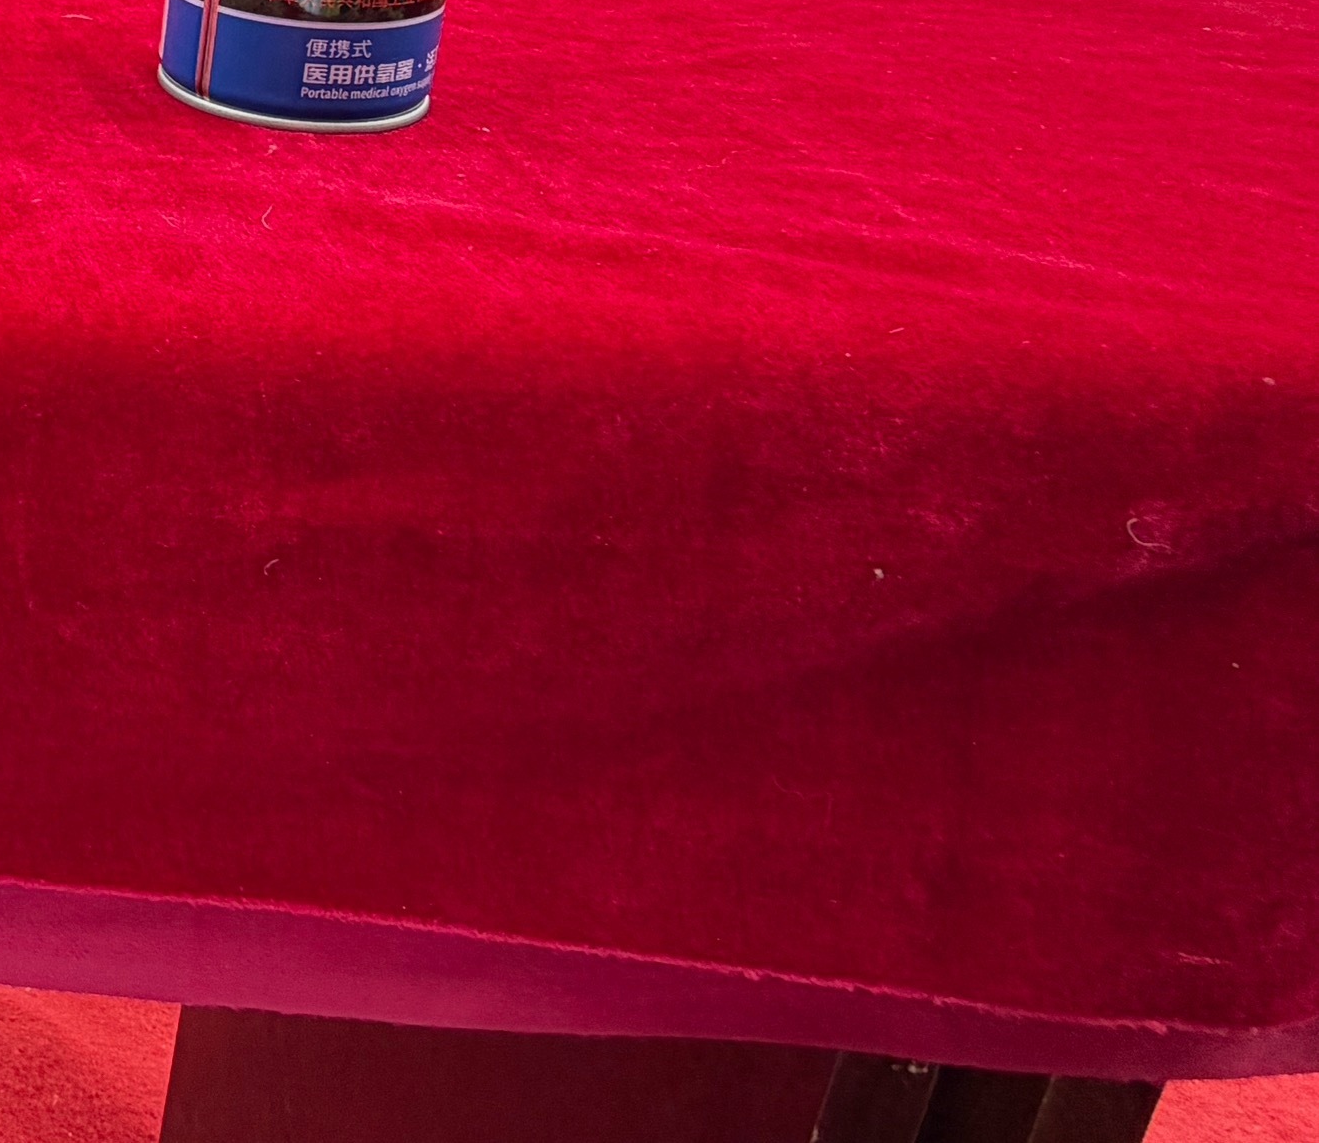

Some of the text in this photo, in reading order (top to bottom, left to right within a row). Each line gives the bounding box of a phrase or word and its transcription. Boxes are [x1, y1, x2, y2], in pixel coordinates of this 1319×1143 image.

[306, 38, 372, 58] 便携式
[301, 86, 349, 100] Portable
[350, 86, 389, 100] medical
